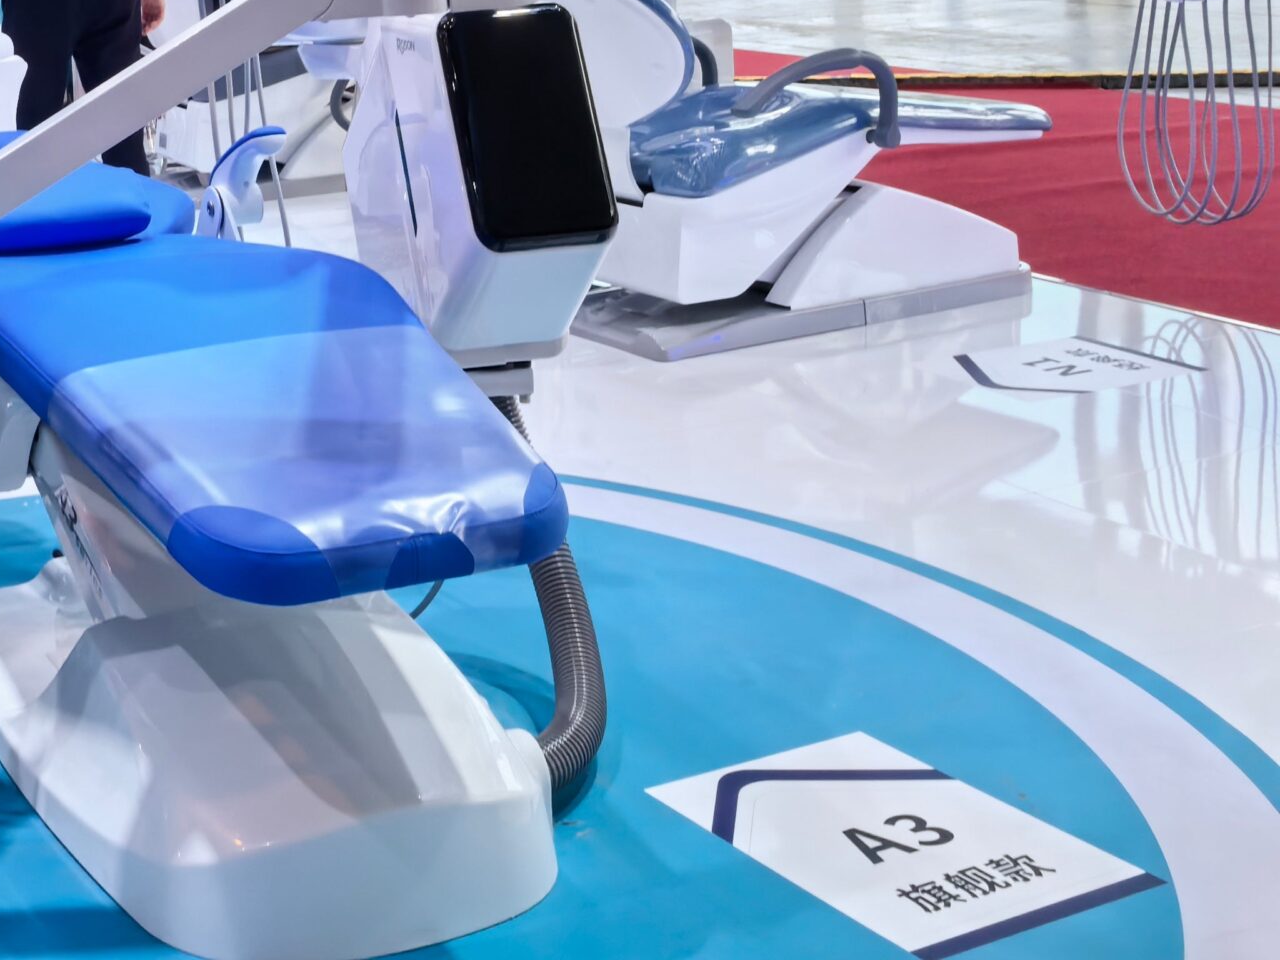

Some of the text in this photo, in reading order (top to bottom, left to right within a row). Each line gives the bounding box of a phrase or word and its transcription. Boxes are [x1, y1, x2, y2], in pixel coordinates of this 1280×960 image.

[842, 814, 955, 865] A3
[896, 854, 1057, 914] 旗舰款
